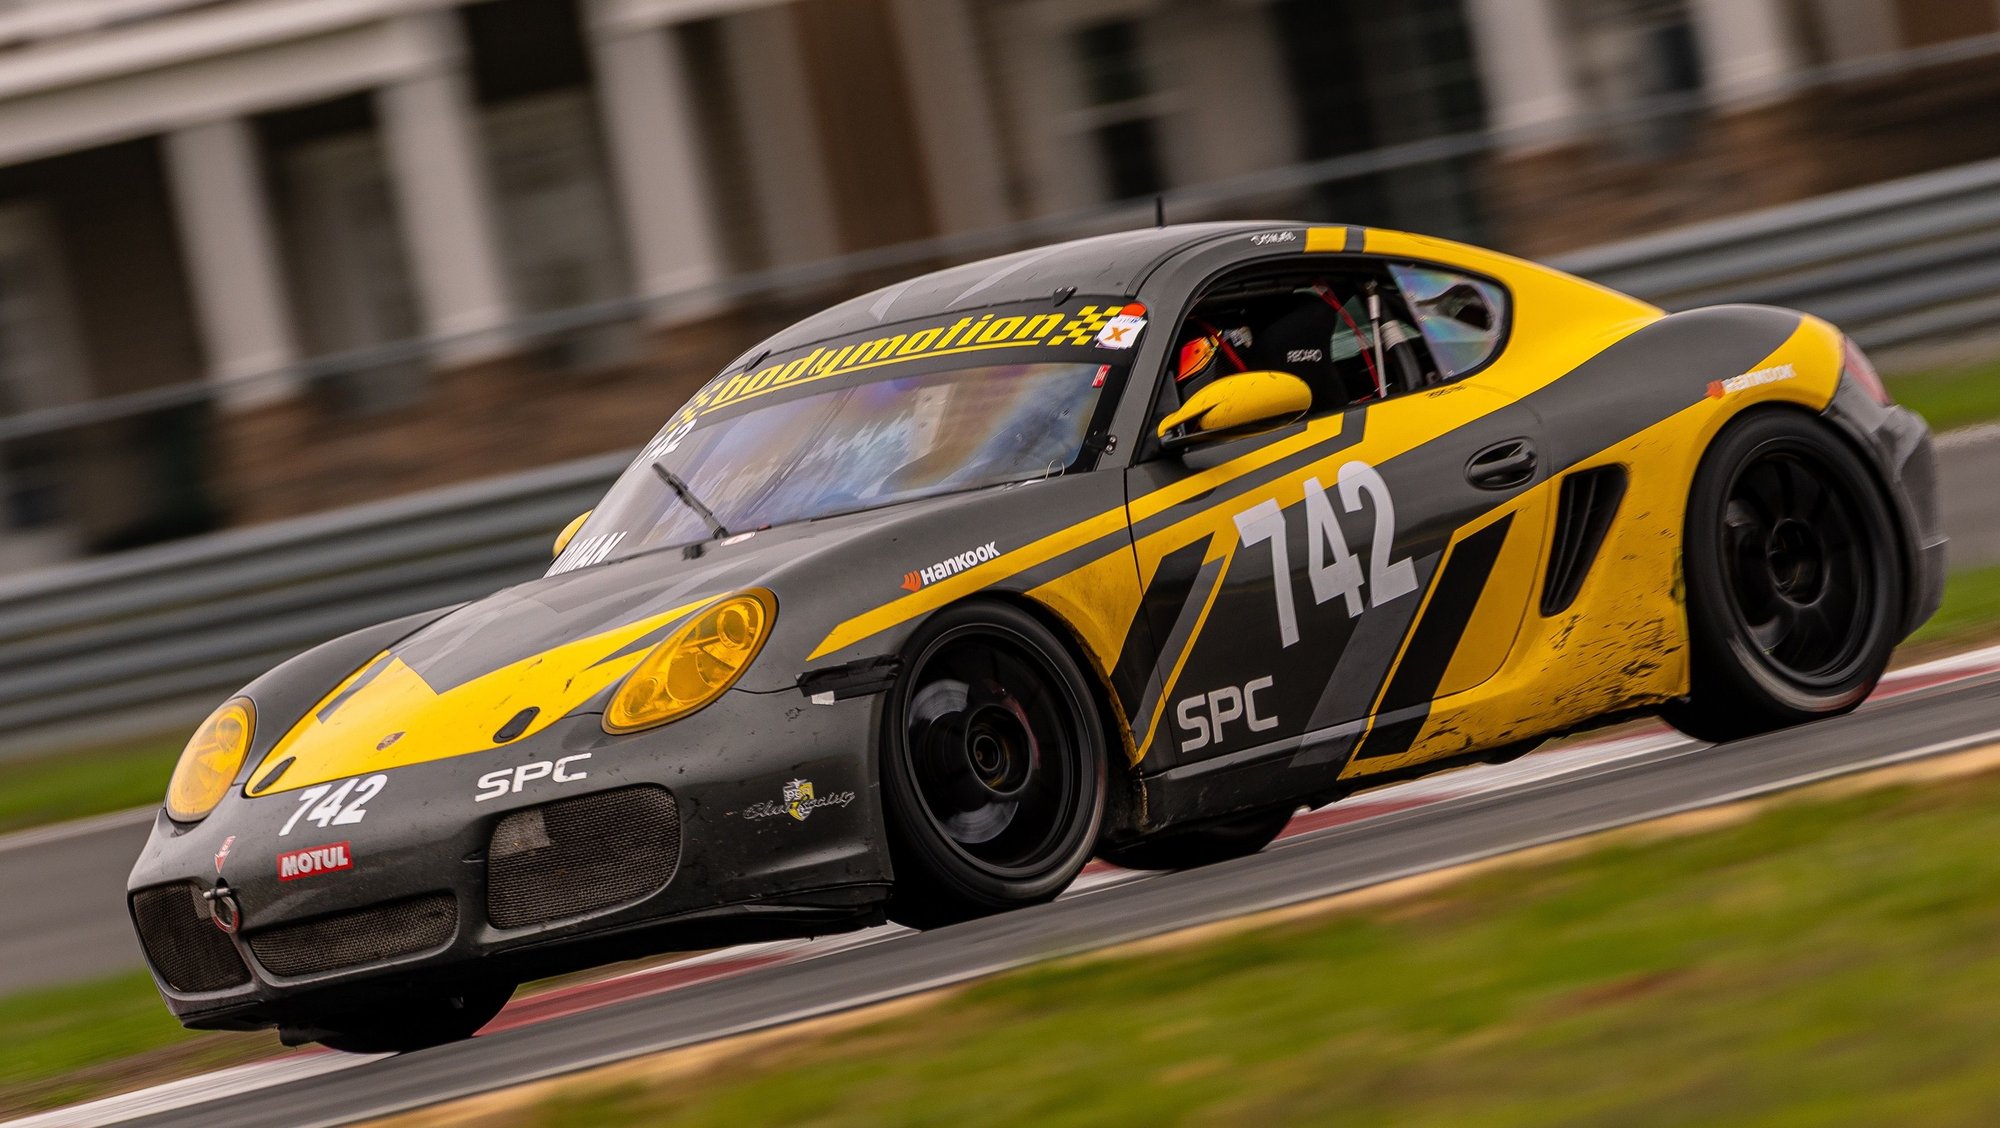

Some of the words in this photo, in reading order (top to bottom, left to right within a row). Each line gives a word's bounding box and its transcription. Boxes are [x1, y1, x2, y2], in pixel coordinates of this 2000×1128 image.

[708, 313, 1065, 407] bodymotion
[632, 418, 697, 472] 742
[1233, 460, 1419, 648] 742
[1177, 675, 1279, 752] SPC
[278, 774, 387, 836] 742
[475, 752, 592, 802] SPC
[281, 846, 349, 878] MOTUL
